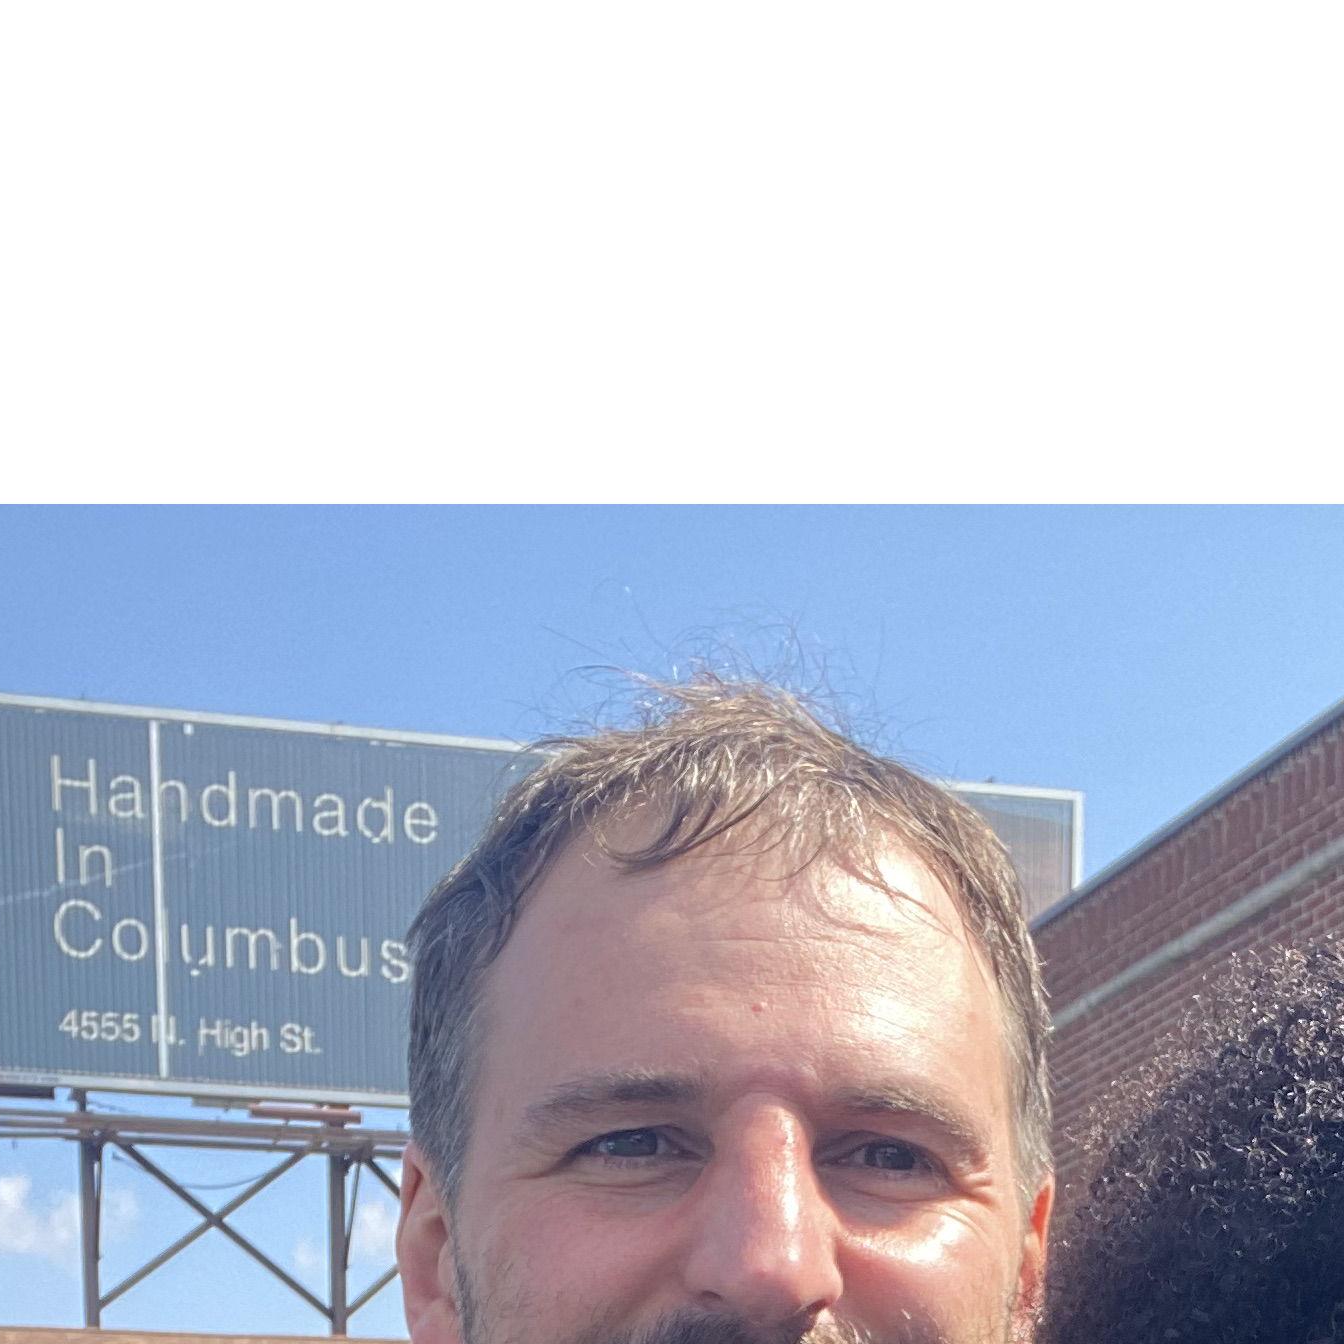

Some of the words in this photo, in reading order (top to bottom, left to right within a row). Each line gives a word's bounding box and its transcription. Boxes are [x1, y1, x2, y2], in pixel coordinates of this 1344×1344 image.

[50, 754, 439, 845] Handmade
[55, 827, 113, 888] In
[58, 1009, 141, 1043] 4555
[198, 1017, 270, 1057] High
[279, 1022, 321, 1054] St.
